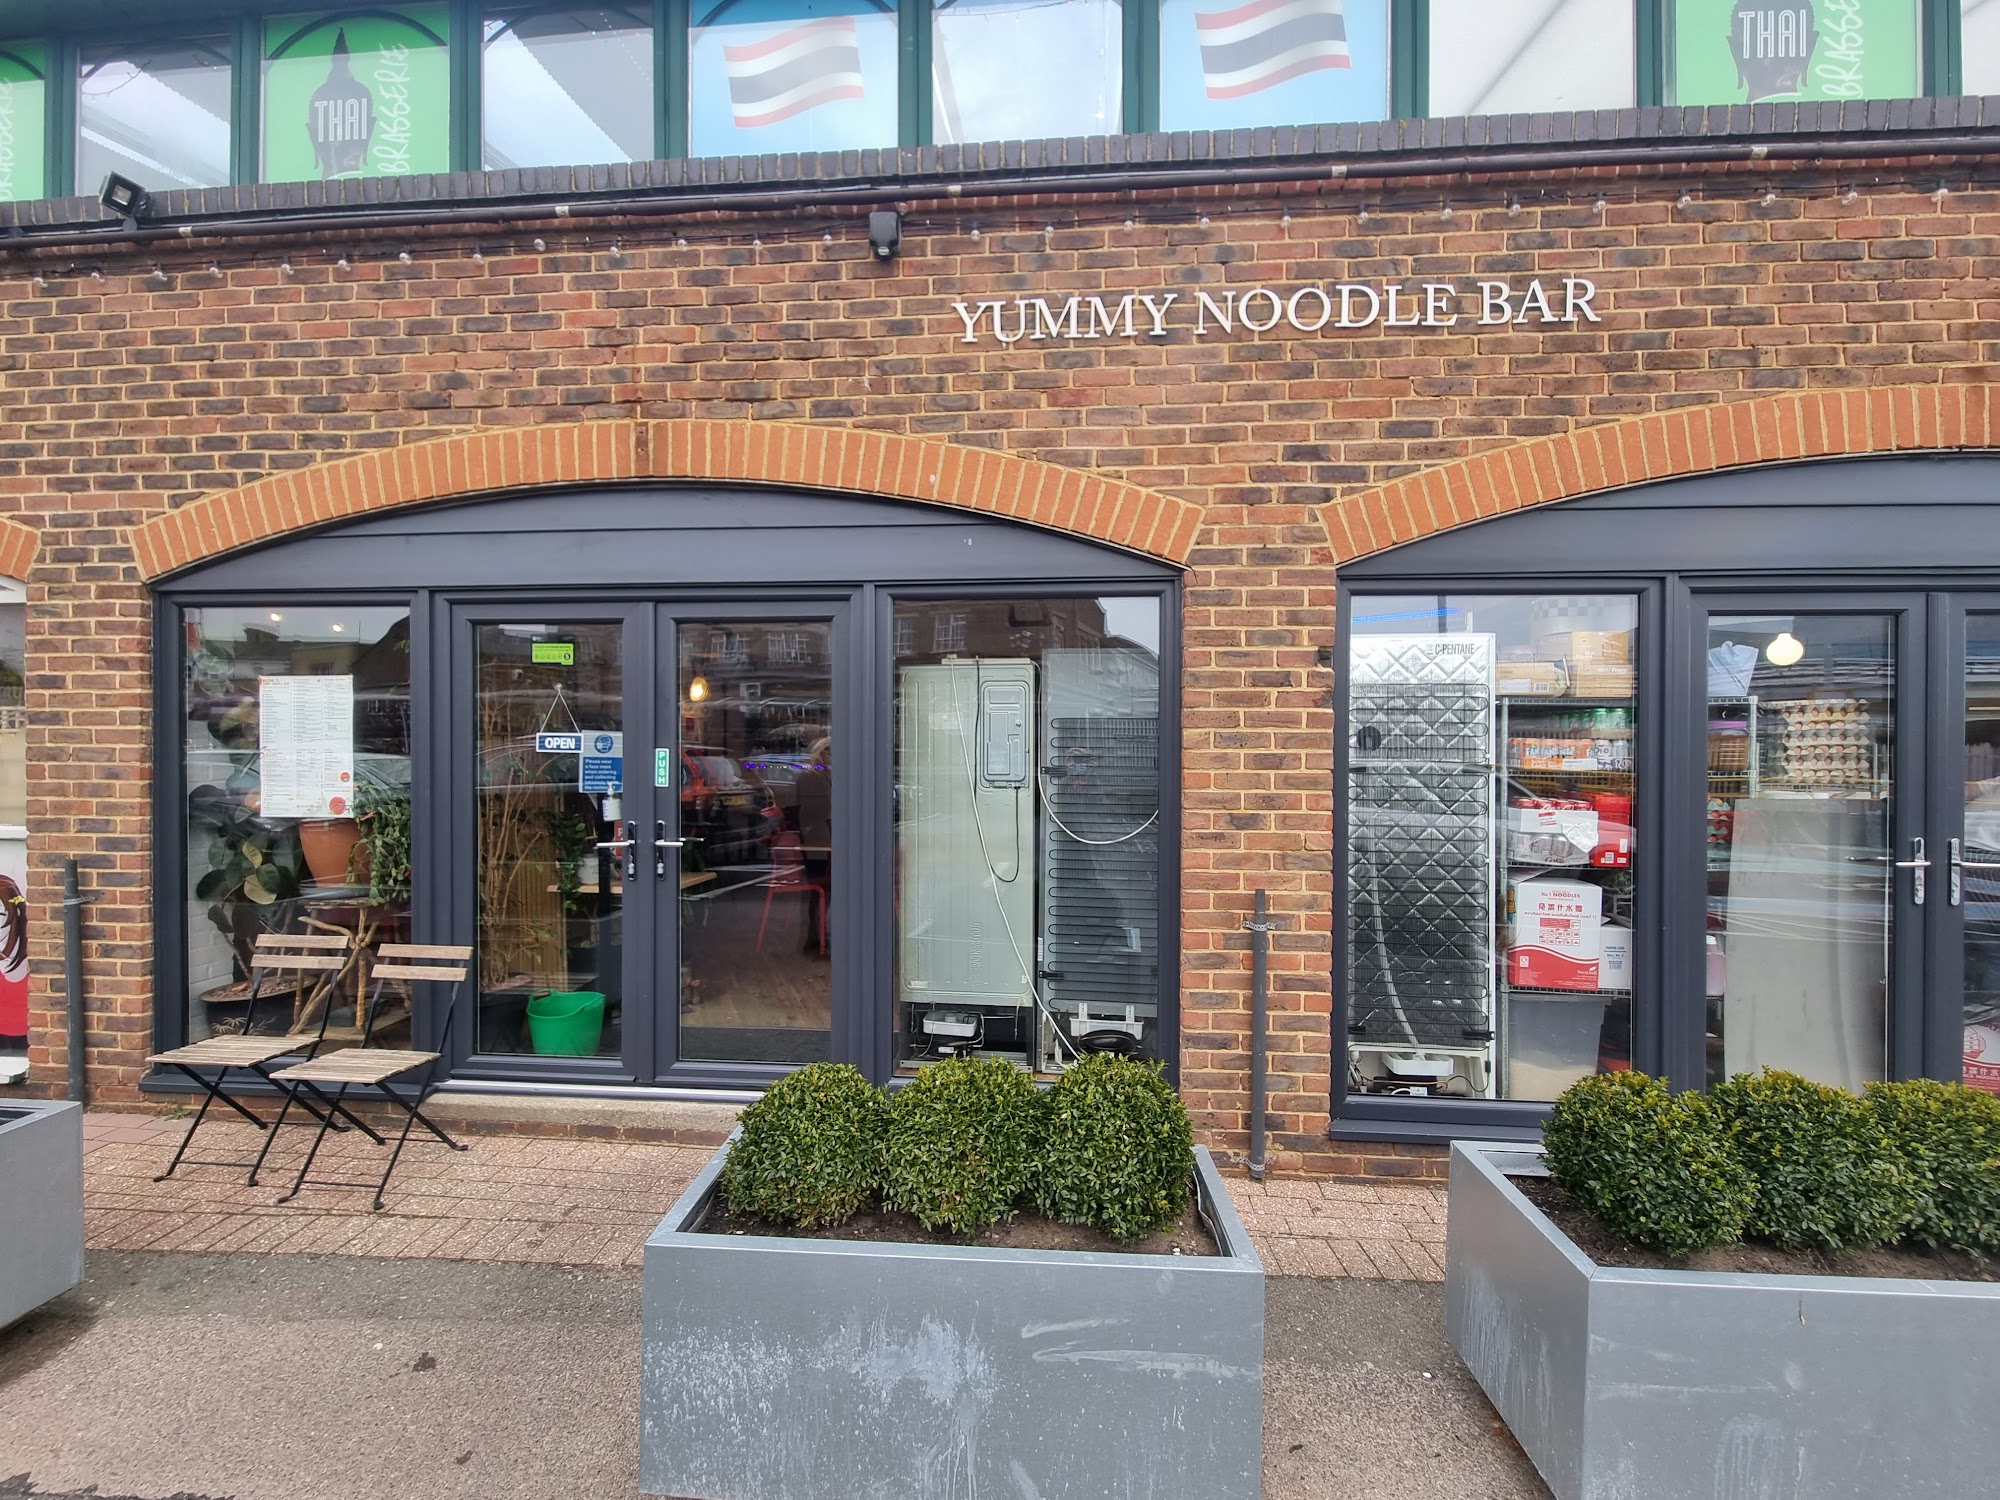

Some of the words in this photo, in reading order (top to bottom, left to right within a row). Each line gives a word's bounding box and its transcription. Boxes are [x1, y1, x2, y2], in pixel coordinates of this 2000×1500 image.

[1738, 9, 1807, 59] THAI
[315, 98, 367, 142] THAI
[373, 43, 411, 174] BRASSERIE
[951, 293, 1178, 345] YUMMY
[1192, 283, 1457, 336] NOODLE
[1476, 278, 1601, 326] BAR
[1435, 643, 1475, 655] C-PENTANE
[544, 737, 576, 749] OPEN
[658, 751, 666, 784] PUSH
